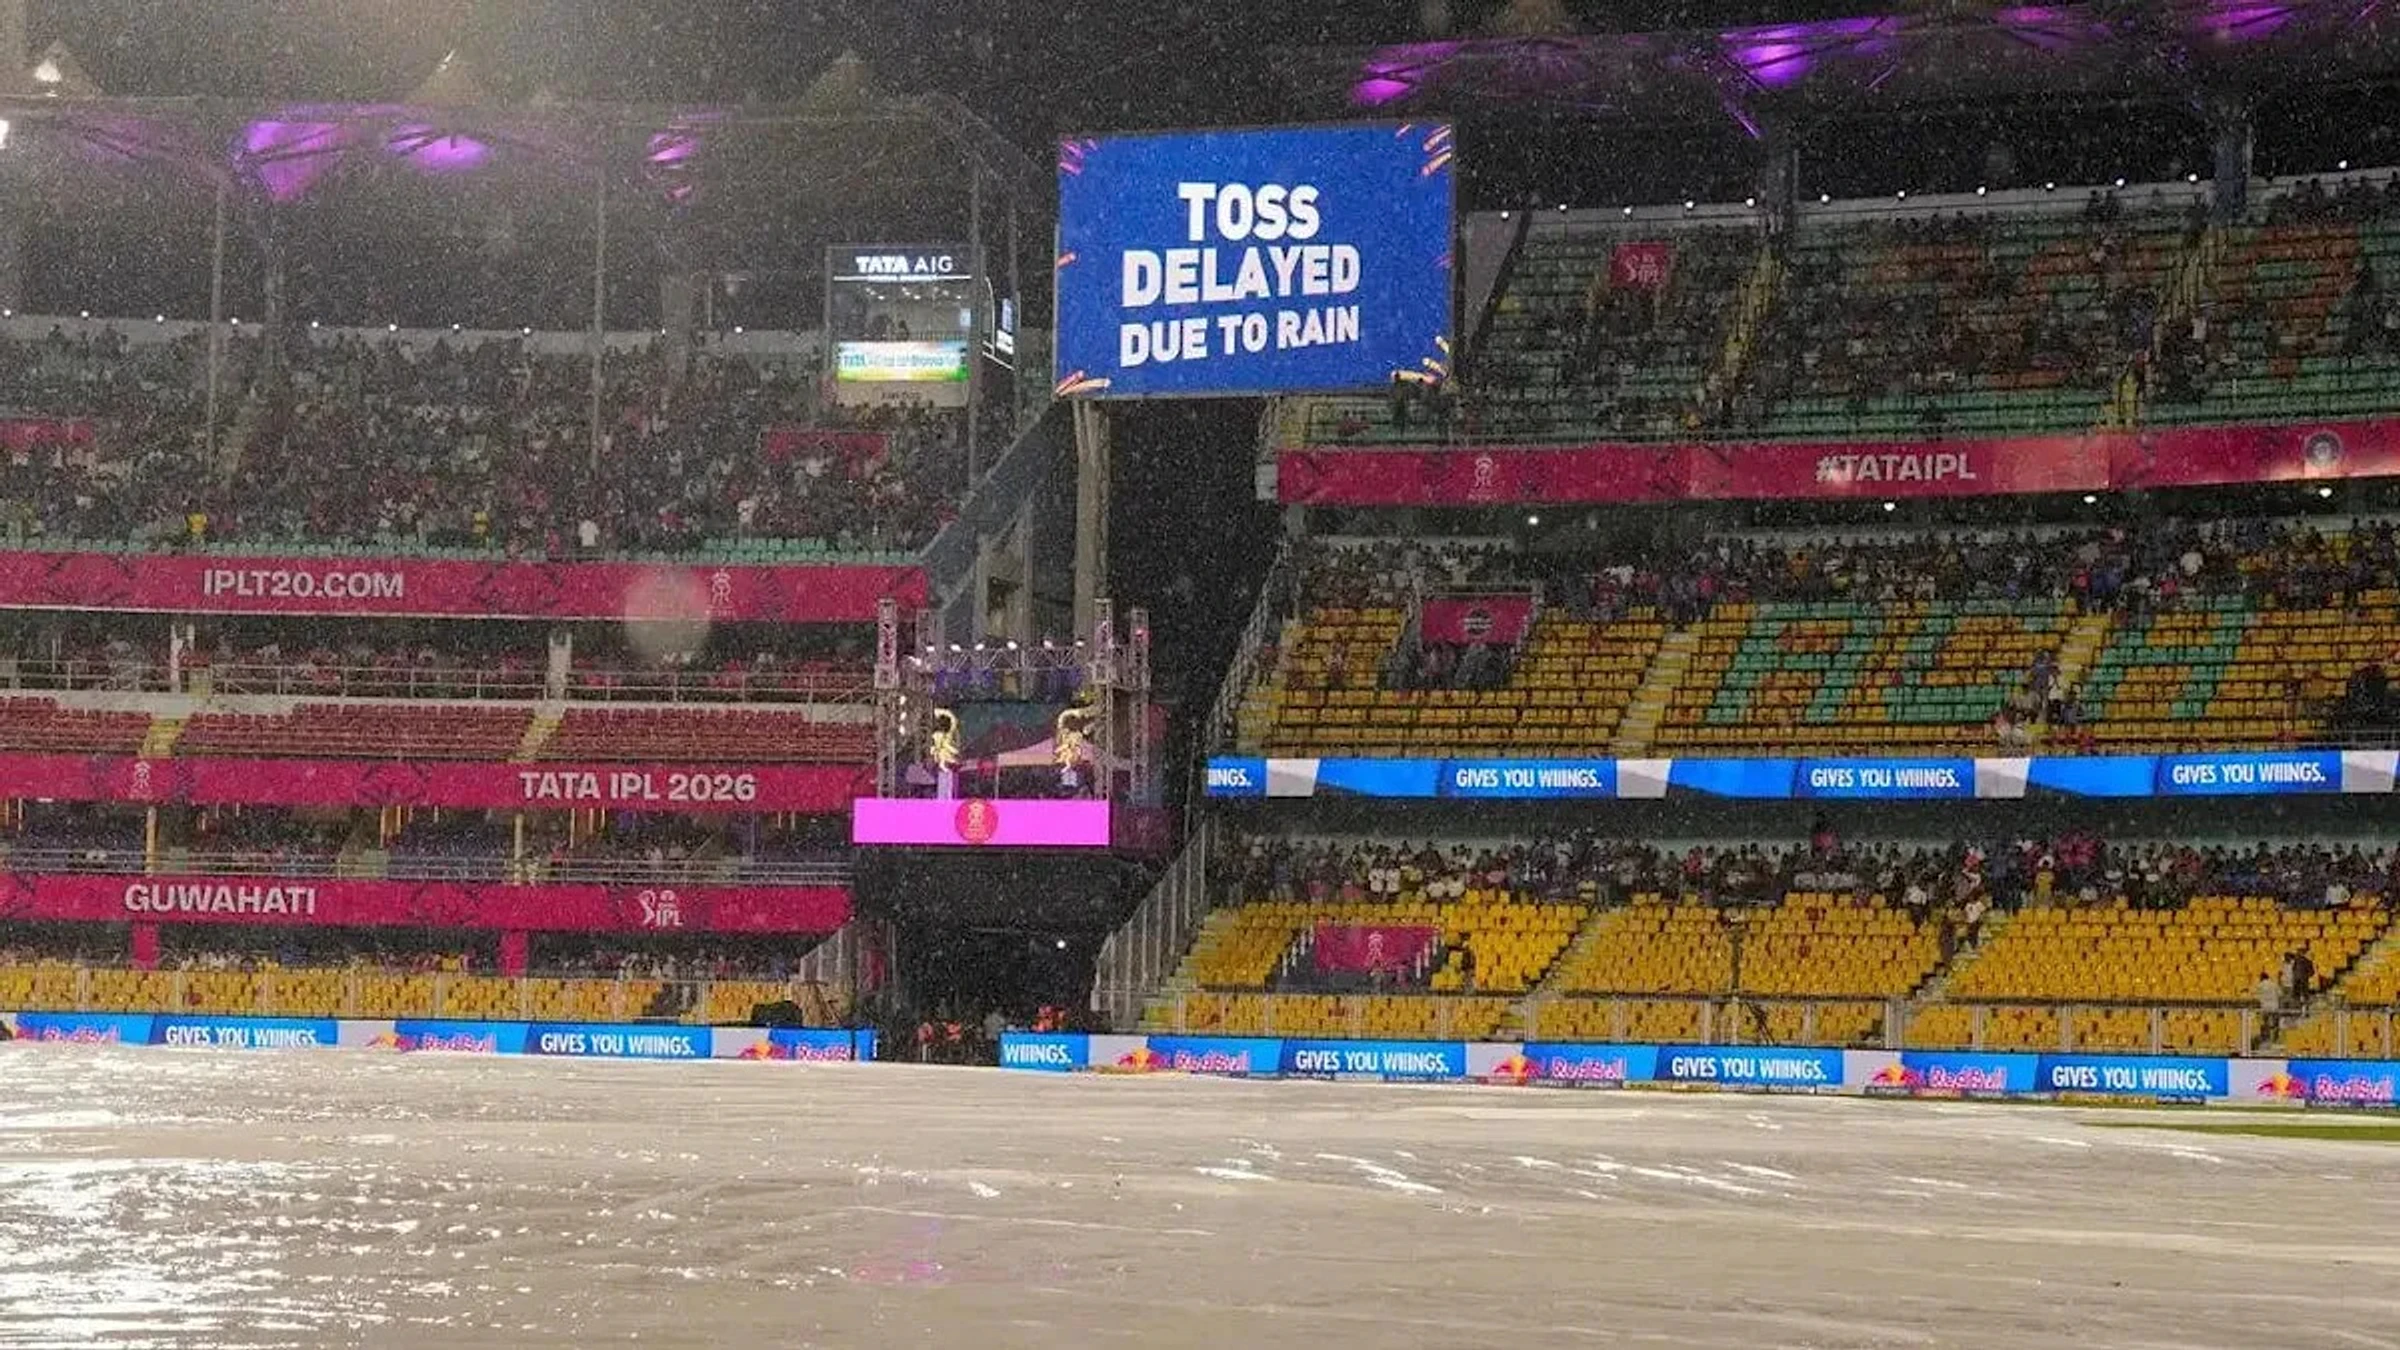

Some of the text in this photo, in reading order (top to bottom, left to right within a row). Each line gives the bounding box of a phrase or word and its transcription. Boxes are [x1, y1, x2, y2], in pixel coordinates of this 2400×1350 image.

[1178, 182, 1320, 241] TOSS
[856, 255, 953, 274] TATA AIG
[1122, 244, 1361, 308] DELAYED
[1120, 305, 1360, 368] DUE TO RAIN
[1816, 453, 1977, 482] #TATAIPL
[203, 569, 404, 598] IPLT20.COM
[1456, 768, 1499, 788] GIVES
[1503, 768, 1535, 788] YOU
[1811, 768, 1854, 788] GIVES
[1859, 768, 1891, 788] YOU
[2172, 764, 2217, 784] GIVES
[2221, 762, 2254, 783] YOU
[519, 772, 757, 802] TATA IPL 2026
[124, 883, 316, 914] GUWAHATI
[655, 909, 684, 928] IPL
[165, 1026, 211, 1045] GIVES
[215, 1027, 248, 1046] YOU
[540, 1033, 585, 1053] GIVES
[590, 1034, 624, 1054] YOU
[1295, 1050, 1340, 1071] GIVES
[1344, 1051, 1378, 1072] YOU
[1671, 1057, 1717, 1077] GIVES
[1721, 1058, 1755, 1078] YOU
[2051, 1066, 2098, 1088] GIVES
[2102, 1066, 2138, 1089] YOU
